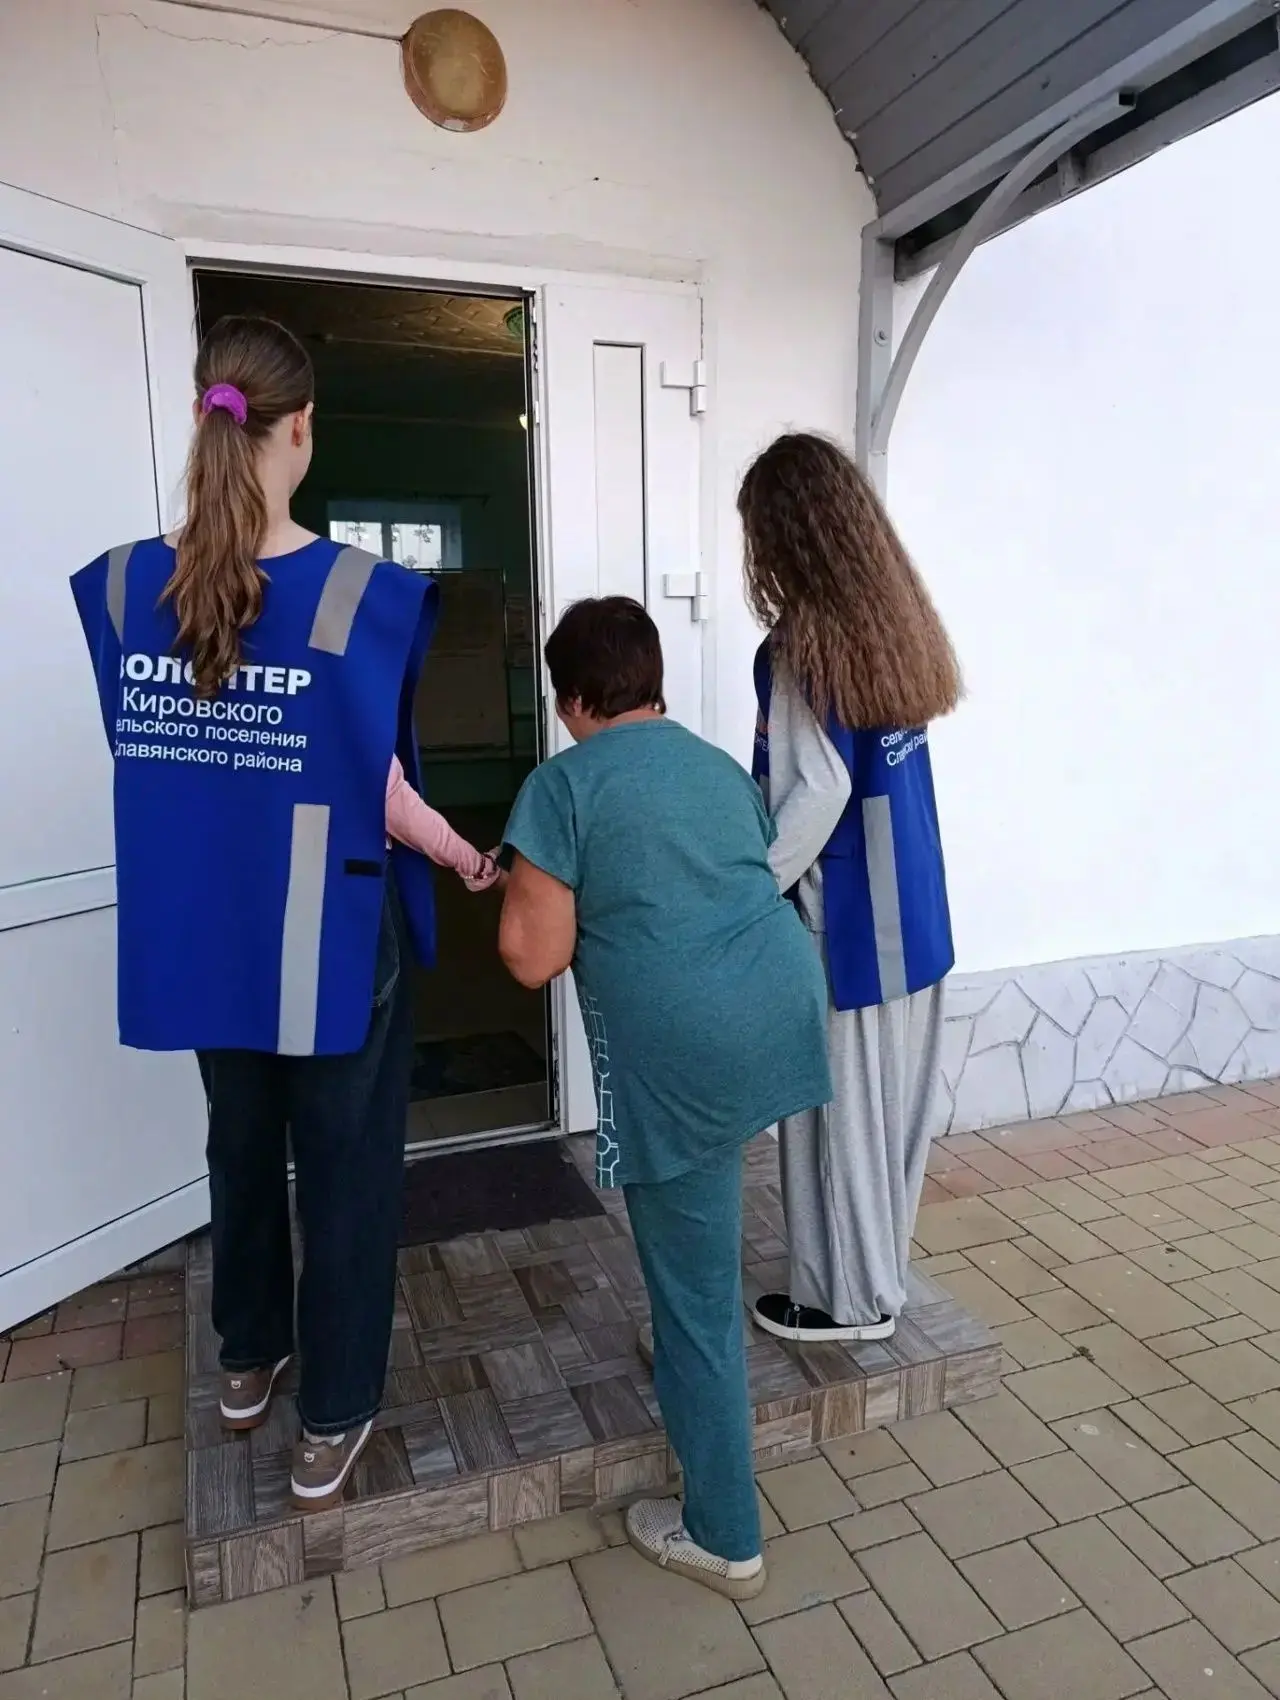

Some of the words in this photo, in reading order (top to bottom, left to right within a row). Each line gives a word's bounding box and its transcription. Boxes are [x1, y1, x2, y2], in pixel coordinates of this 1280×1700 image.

[123, 687, 282, 725] Кировского
[116, 718, 199, 738] ельского
[205, 726, 306, 749] поселения
[115, 739, 228, 765] лавянского
[233, 751, 303, 773] района
